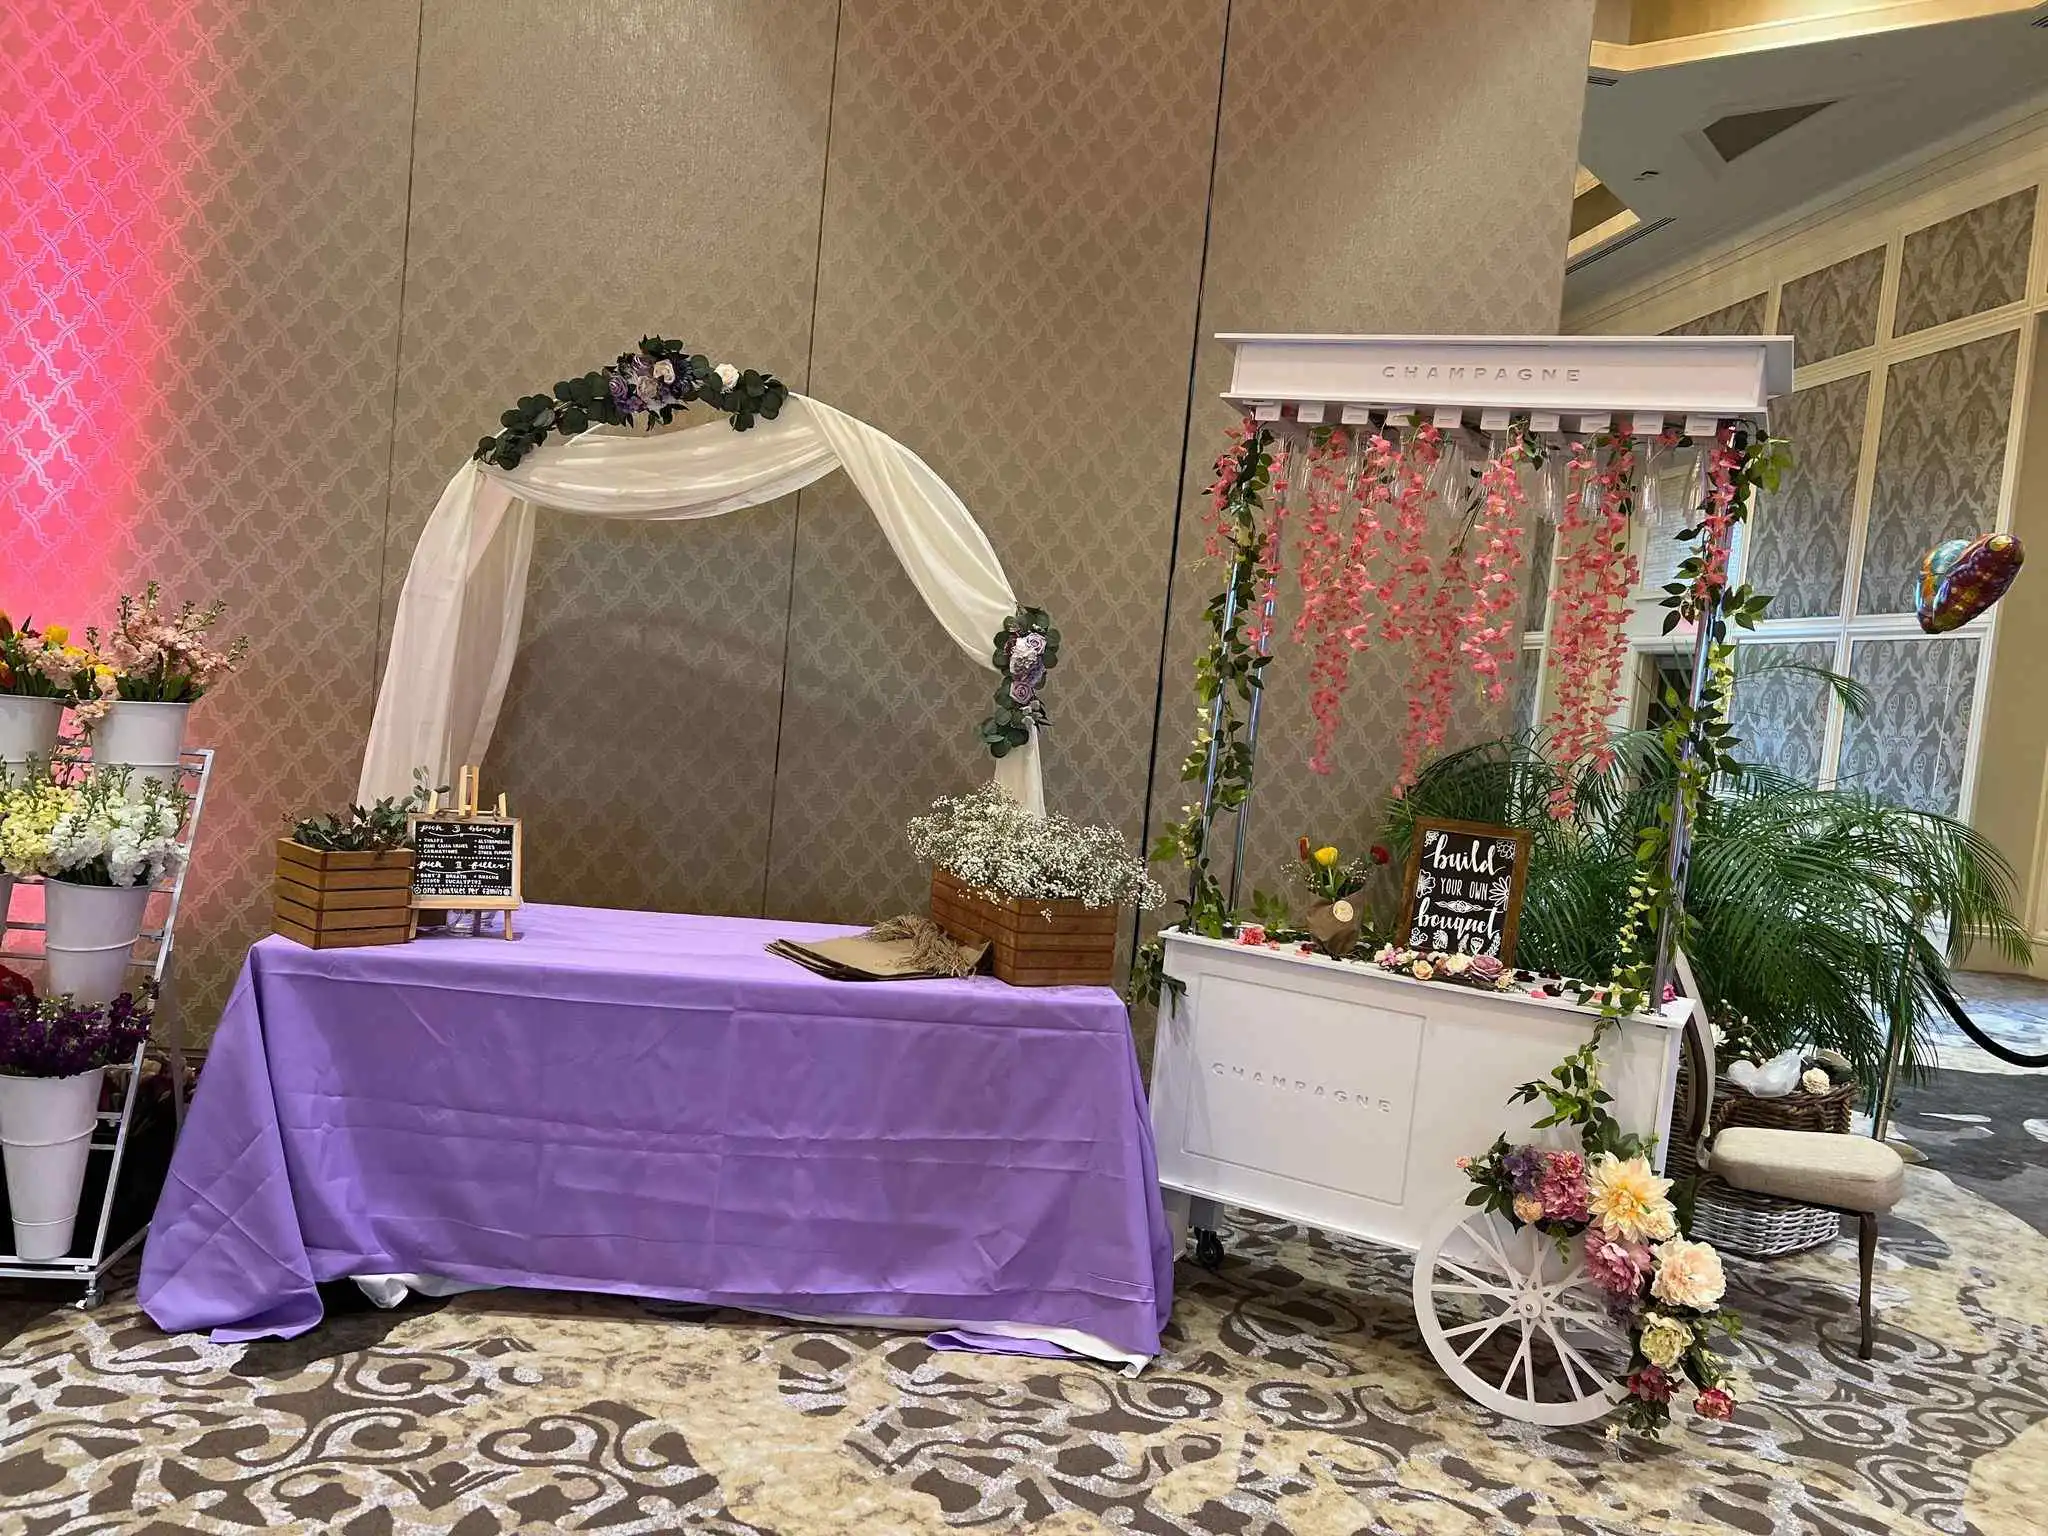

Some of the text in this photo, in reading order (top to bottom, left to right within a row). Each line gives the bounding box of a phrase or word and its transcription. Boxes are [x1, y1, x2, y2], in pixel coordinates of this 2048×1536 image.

[1382, 365, 1581, 382] CHAMPAGNE
[418, 824, 444, 832] pick
[452, 824, 460, 833] 3
[417, 861, 444, 869] pick
[1424, 834, 1506, 875] build
[1441, 877, 1488, 901] YOUR OWN
[1413, 897, 1503, 940] bouquet
[1211, 1062, 1391, 1114] CHAMPAGNE
